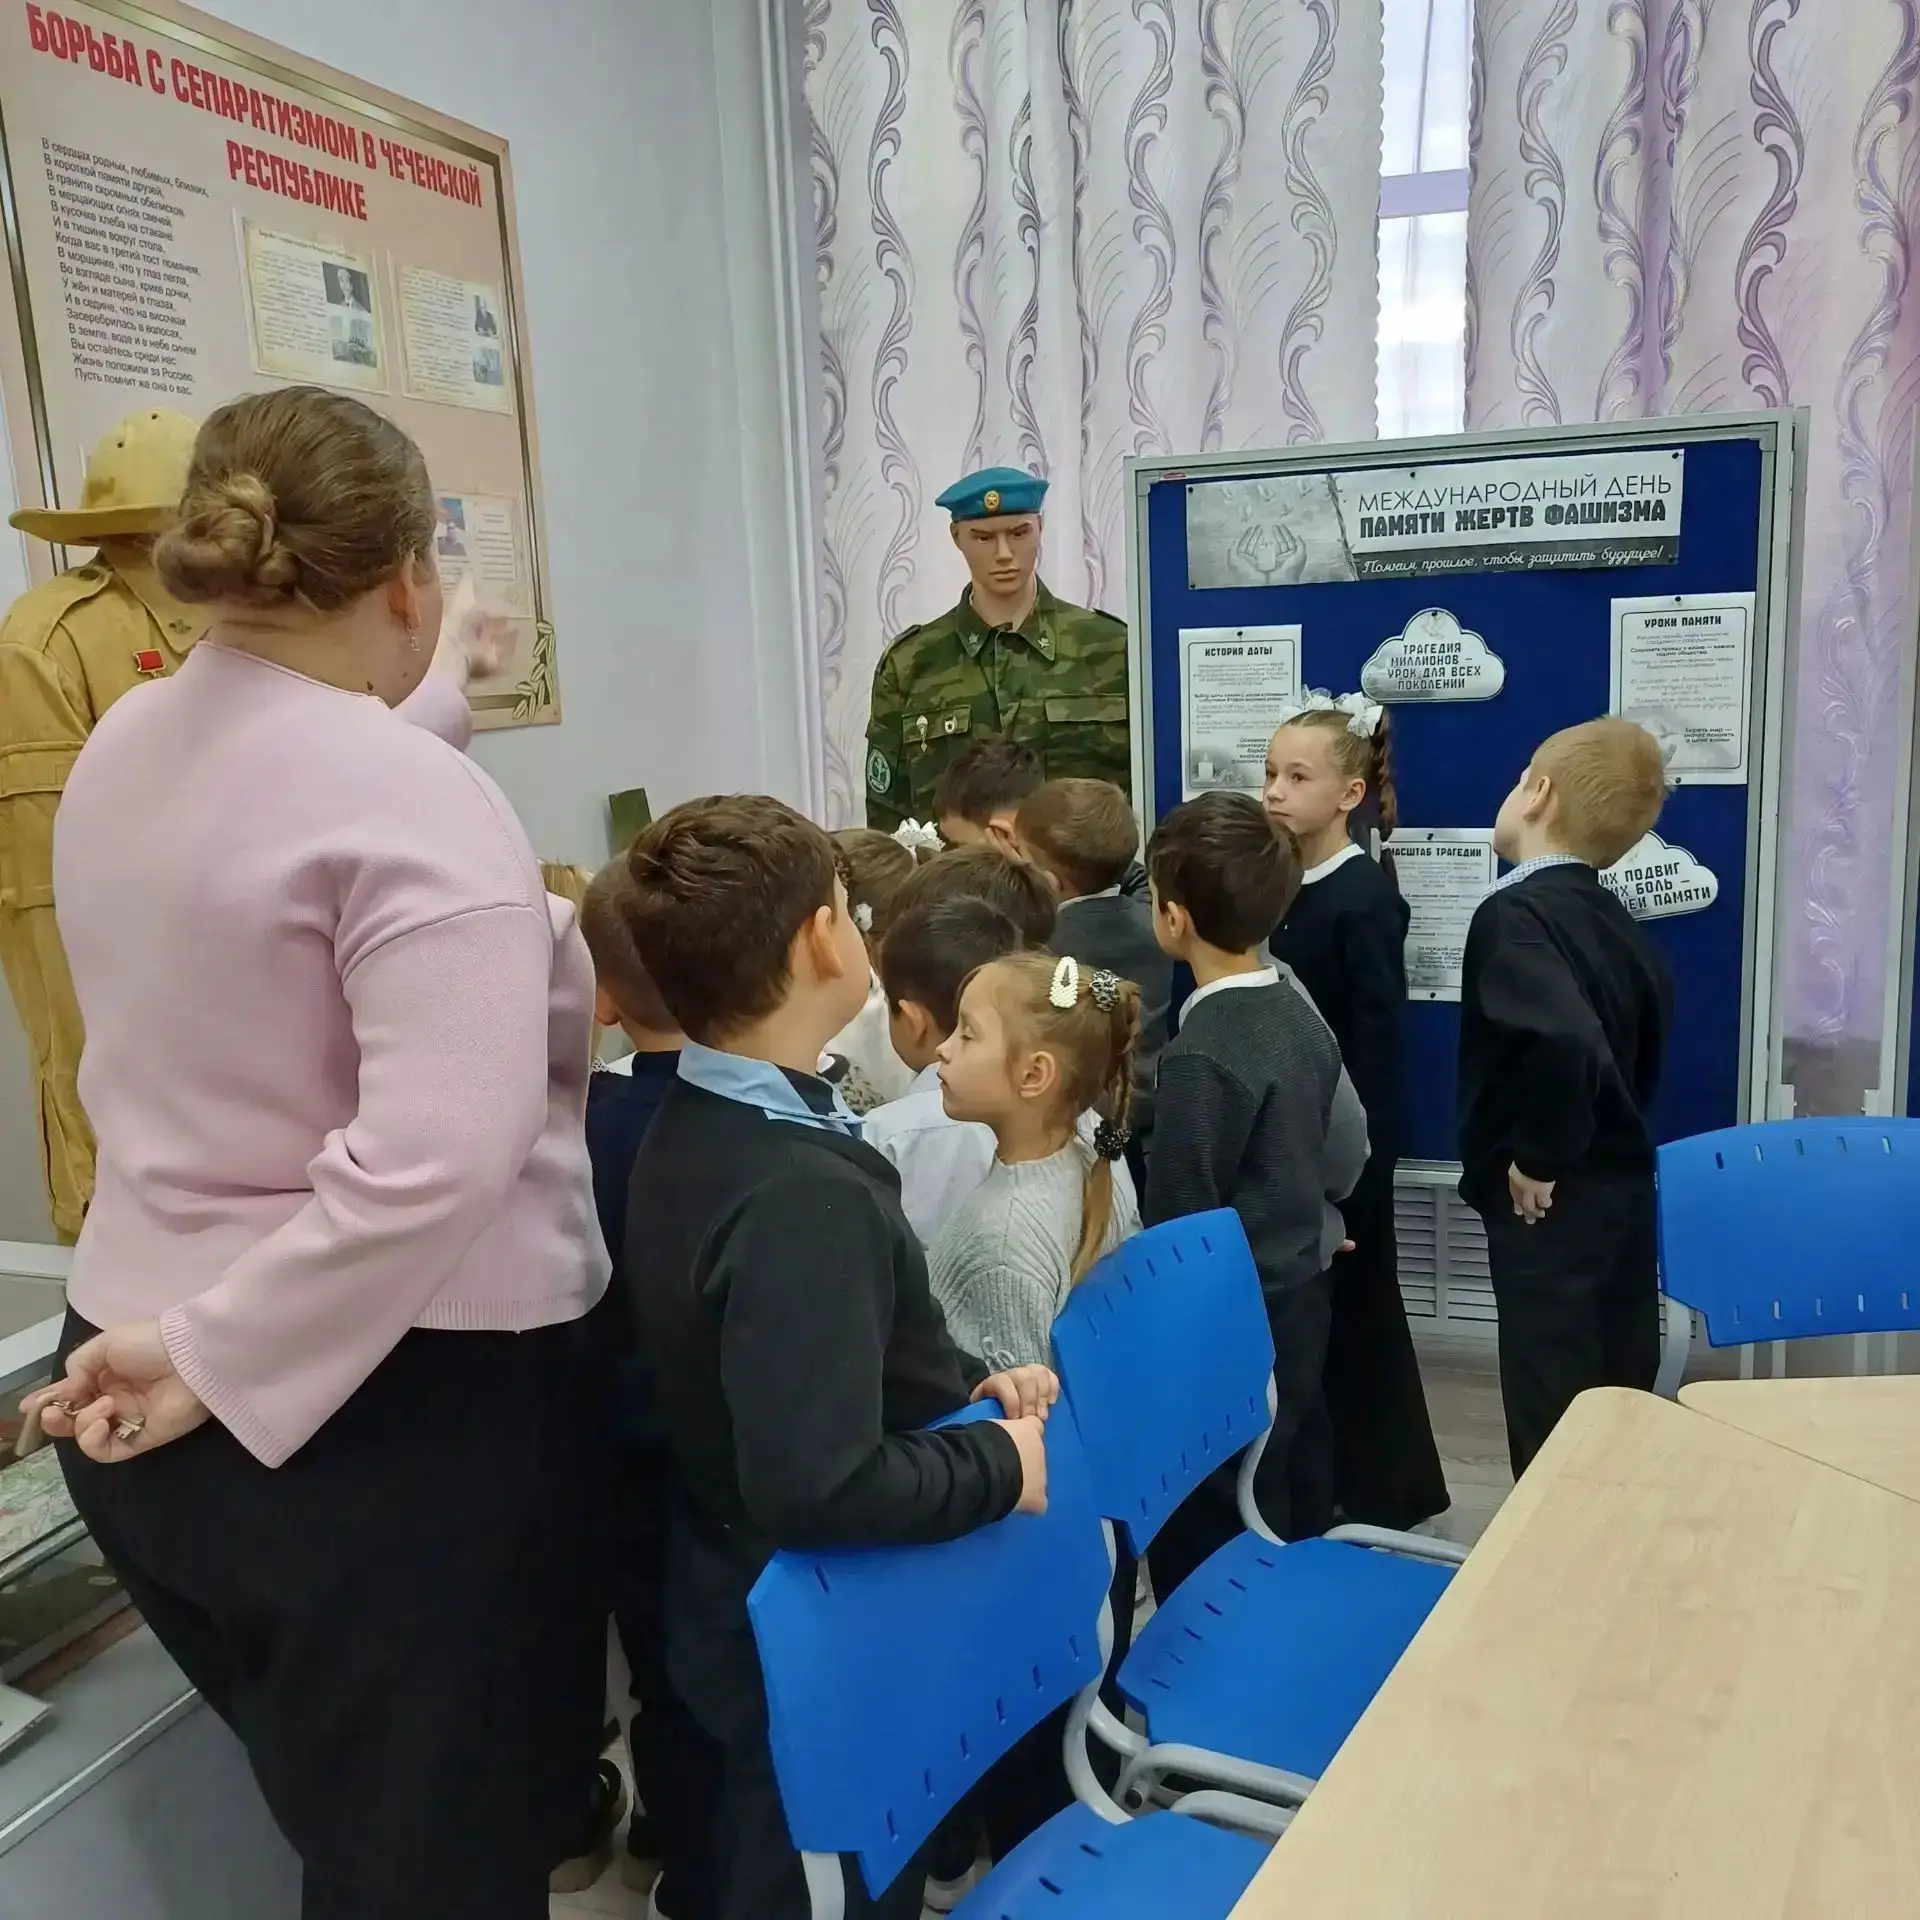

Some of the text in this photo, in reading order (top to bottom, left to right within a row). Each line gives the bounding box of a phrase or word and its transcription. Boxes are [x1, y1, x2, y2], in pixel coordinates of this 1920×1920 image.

[26, 1, 482, 208] БОРЬБА С СЕПАРАТИЗМОМ В ЧЕЧЕНСКОЙ
[42, 137, 49, 149] В
[52, 143, 91, 161] сердцах
[93, 155, 129, 174] родных,
[44, 153, 51, 165] В
[54, 159, 96, 177] короткой
[98, 171, 130, 187] памяти
[226, 139, 367, 222] РЕСПУБЛИКЕ
[46, 169, 54, 181] В
[56, 174, 93, 191] граните
[95, 185, 139, 204] скромных
[49, 184, 56, 196] В
[59, 190, 115, 212] мерцающих
[51, 200, 58, 211] В
[61, 205, 97, 221] кусочке
[99, 214, 125, 229] хлеба
[127, 222, 138, 232] на
[53, 215, 61, 226] И
[64, 220, 69, 229] в
[72, 222, 106, 239] тишине
[109, 232, 136, 247] вокруг
[56, 231, 82, 247] Когда
[85, 240, 101, 251] вас
[103, 245, 108, 253] в
[111, 247, 140, 261] третий
[142, 254, 160, 265] тост
[58, 246, 65, 258] В
[68, 251, 117, 270] морщинке,
[119, 264, 134, 273] что
[136, 267, 141, 277] у
[143, 268, 161, 280] глаз
[60, 262, 73, 274] Во
[76, 267, 110, 283] взгляде
[62, 277, 68, 288] У
[71, 280, 89, 292] жён
[100, 287, 137, 302] матерей
[140, 296, 144, 304] в
[64, 292, 72, 303] И
[75, 296, 80, 305] в
[119, 306, 134, 316] что
[137, 309, 147, 318] на
[66, 307, 136, 330] Засеребрилась
[138, 324, 144, 332] в
[69, 322, 76, 333] В
[111, 332, 132, 344] воде
[135, 337, 140, 345] и
[142, 339, 147, 347] в
[149, 339, 169, 351] небе
[71, 338, 85, 349] Вы
[134, 350, 159, 363] среди
[72, 352, 103, 367] Жизнь
[105, 360, 148, 374] положили
[150, 368, 160, 376] за
[74, 368, 102, 382] Пусть
[104, 374, 136, 386] помнит
[152, 382, 167, 392] она
[169, 384, 174, 392] о
[1358, 472, 1672, 512] МЕЖДУНАРОДНЫЙ ДЕНЬ
[1360, 499, 1666, 538] ПАМЯТИ ЖЕРТВ ФАШИЗМА
[1362, 545, 1664, 573] Помним прошлое, чтобы защитить будущее!
[1645, 615, 1722, 628] УРОКИ ПАМЯТИ
[1205, 646, 1272, 657] ИСТОРИЯ ДАТЫ
[1390, 655, 1459, 667] МИЛЛИОНОВ
[1403, 642, 1461, 655] ТРАГЕДИЯ
[1387, 665, 1481, 679] УРОК ДЛЯ ВСЕХ
[1436, 848, 1482, 857] ТРАГЕДИИ
[1600, 862, 1680, 886] ИХ ПОДВИГ
[1636, 878, 1673, 895] БОЛЬ
[1654, 886, 1711, 906] ПАМЯТИ
